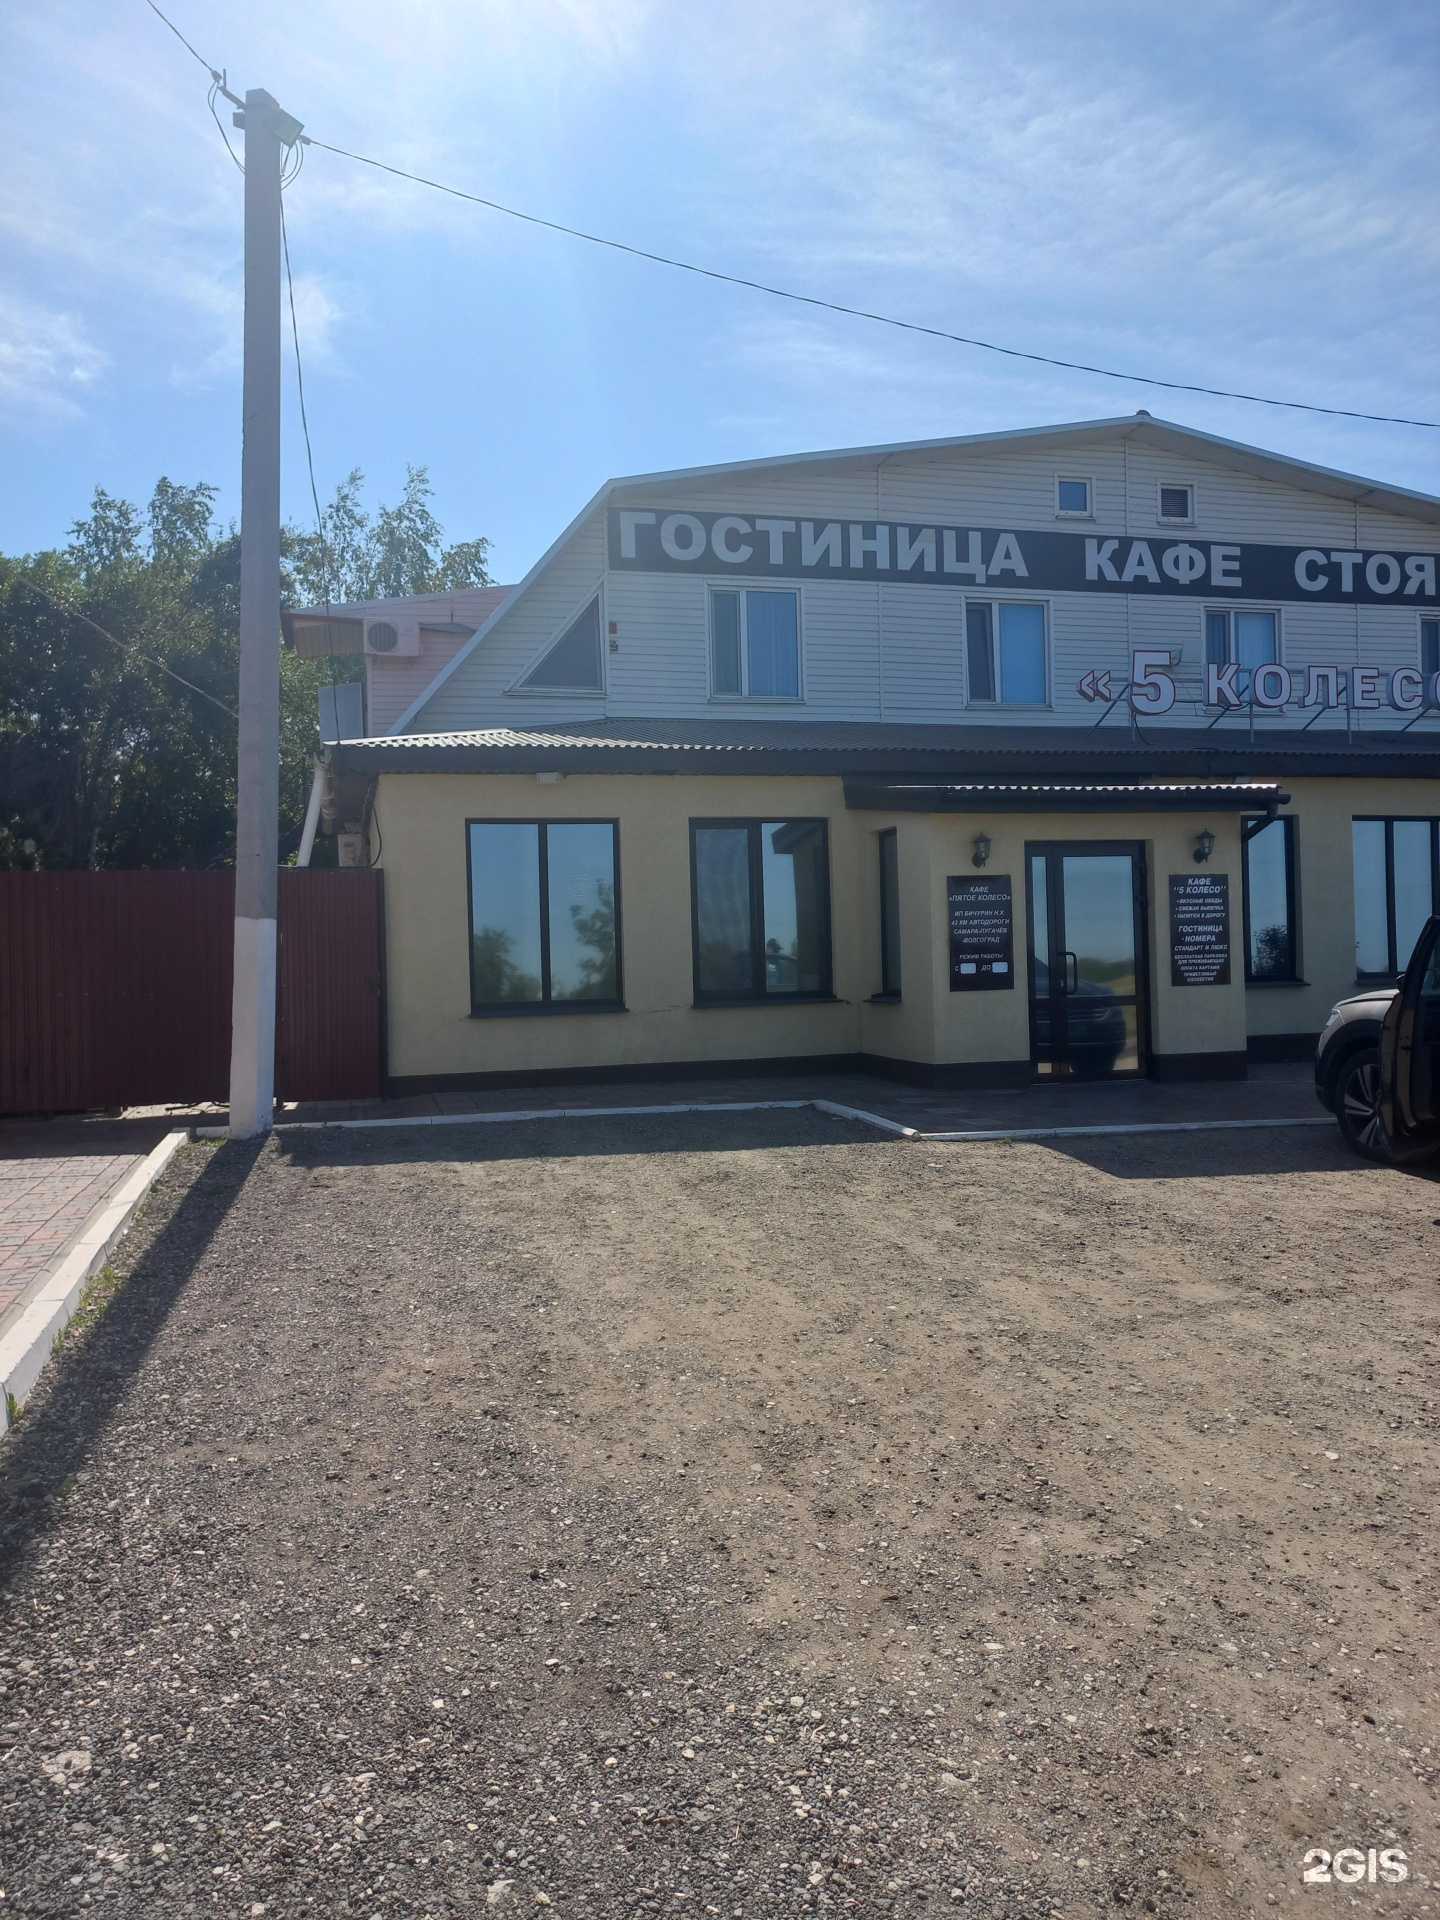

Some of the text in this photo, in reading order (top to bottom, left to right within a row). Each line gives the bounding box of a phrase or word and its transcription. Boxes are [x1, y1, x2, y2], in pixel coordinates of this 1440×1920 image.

[618, 511, 1437, 597] ГОСТИНИЦА КАФЕ СТОЯ
[1204, 662, 1440, 710] КОЛЕС
[1187, 878, 1212, 886] КАФЕ
[1178, 925, 1223, 933] ГОСТИНИЦА
